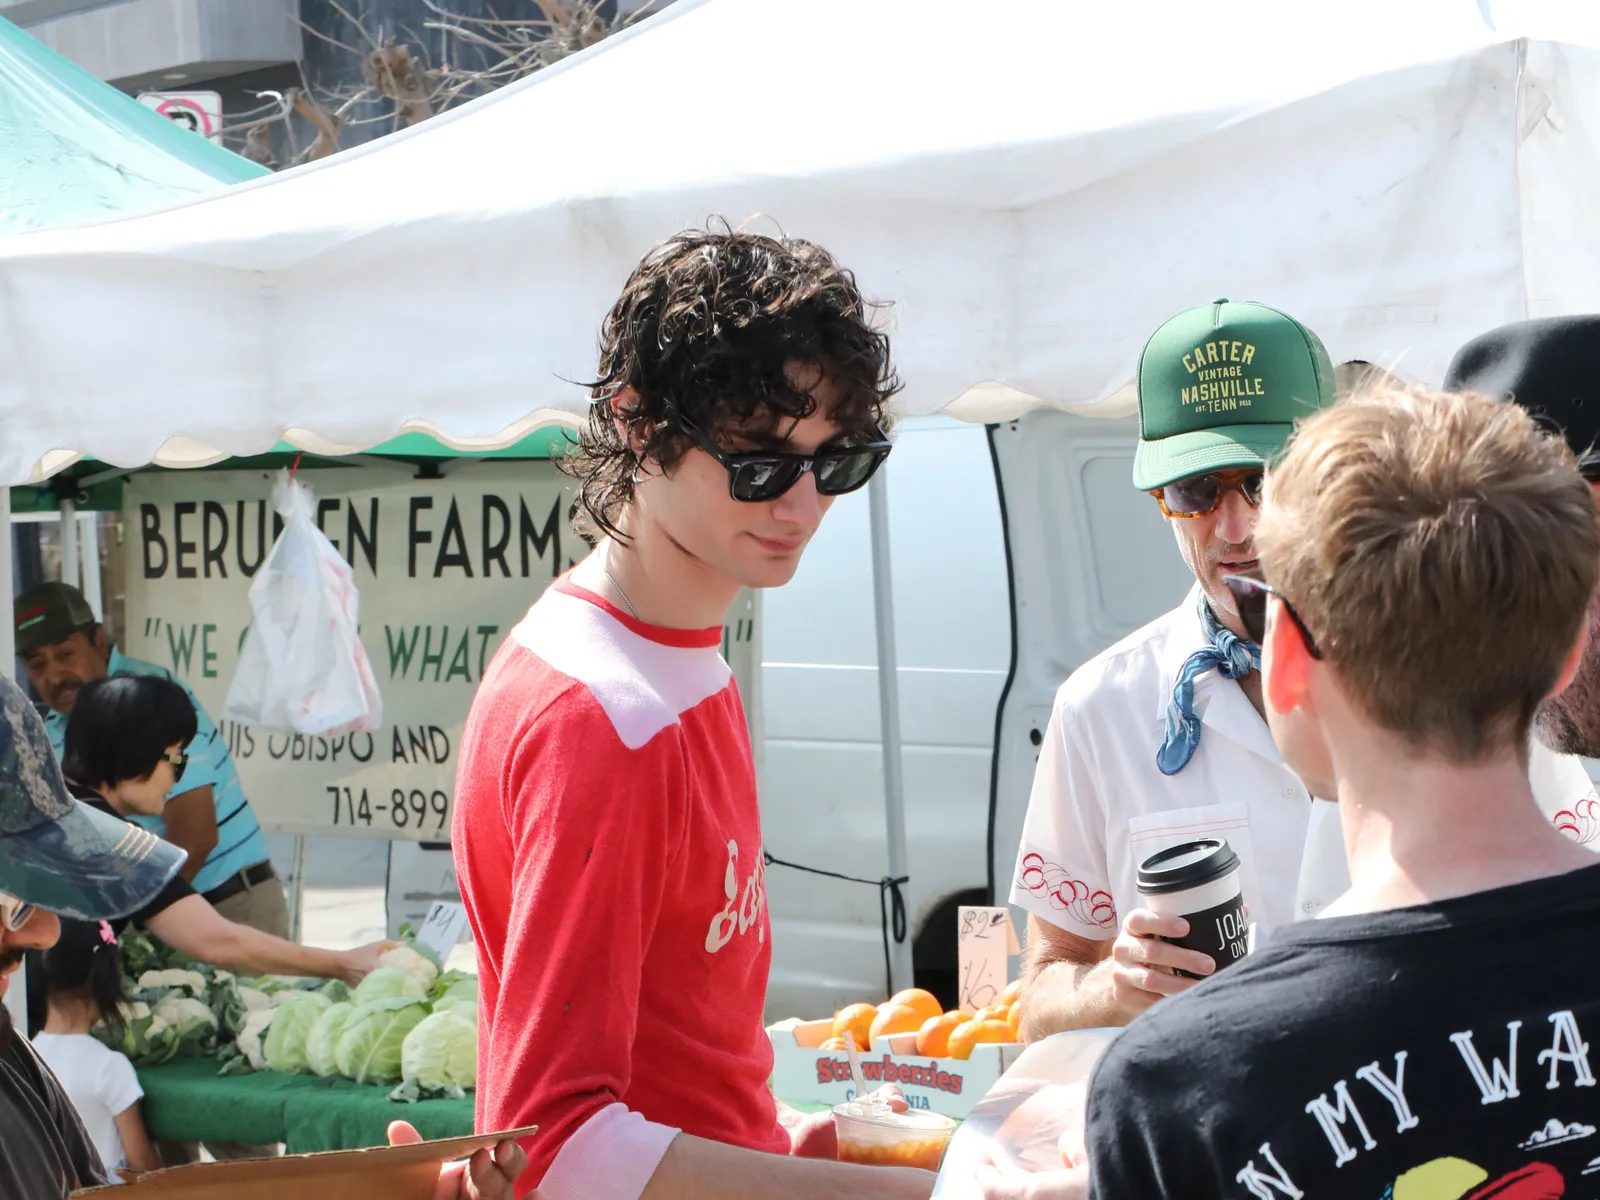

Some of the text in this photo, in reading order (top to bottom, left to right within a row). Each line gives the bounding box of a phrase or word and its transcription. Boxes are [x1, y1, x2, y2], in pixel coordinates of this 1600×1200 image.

[1182, 340, 1256, 373] CARTER
[1198, 366, 1243, 382] VINTAGE
[1181, 378, 1265, 405] NASHVILLE
[1208, 398, 1237, 413] TENN
[140, 492, 578, 579] BERUEN FARM
[384, 624, 498, 683] WHAT
[219, 719, 450, 764] UIS OBISPO AND
[326, 786, 449, 829] 714-899
[1230, 939, 1245, 959] ON
[1304, 1051, 1420, 1168] MY
